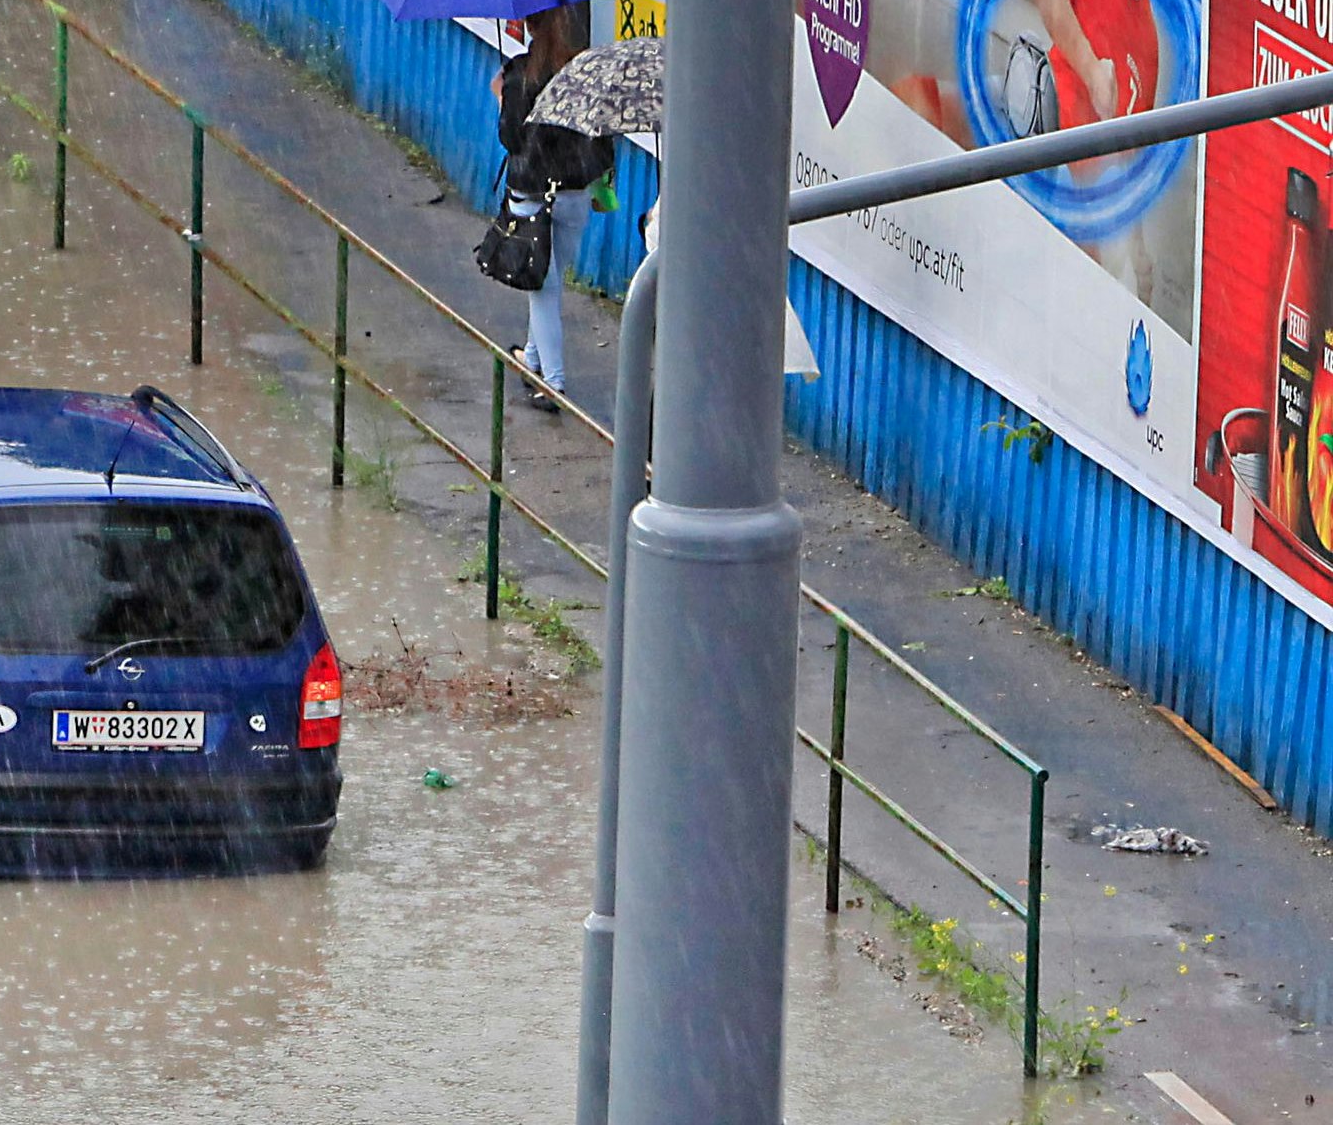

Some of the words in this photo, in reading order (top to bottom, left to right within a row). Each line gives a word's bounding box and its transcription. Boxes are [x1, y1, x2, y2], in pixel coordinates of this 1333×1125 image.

[811, 11, 861, 66] Programme!
[880, 213, 907, 253] oder
[908, 234, 965, 293] upc.at/fit
[1146, 424, 1164, 455] upc
[74, 716, 90, 739] W
[108, 716, 178, 739] 83302
[183, 717, 197, 740] X
